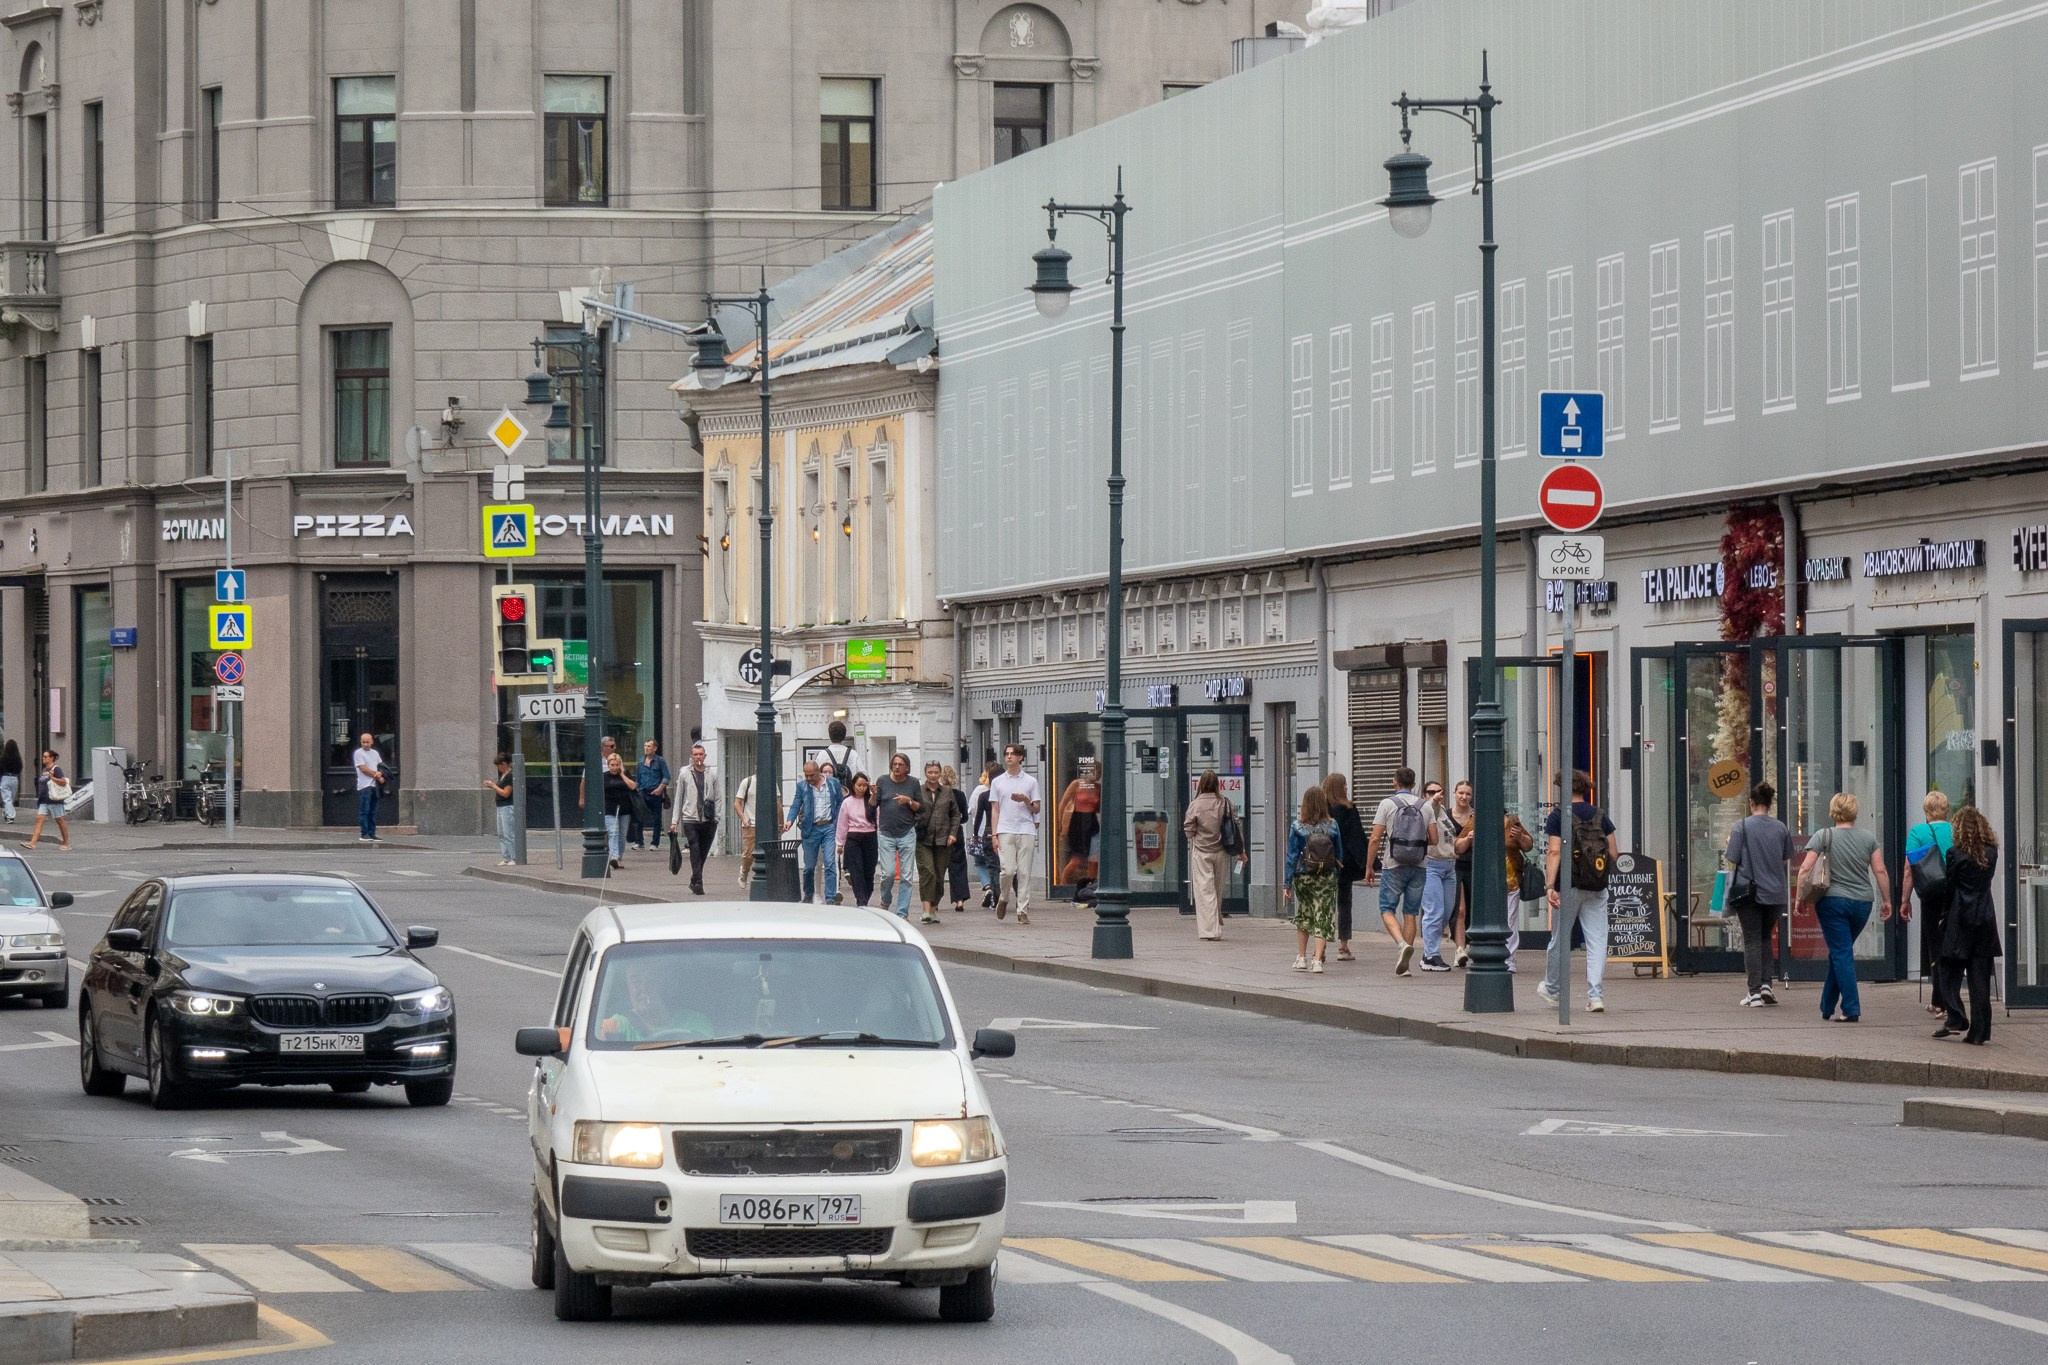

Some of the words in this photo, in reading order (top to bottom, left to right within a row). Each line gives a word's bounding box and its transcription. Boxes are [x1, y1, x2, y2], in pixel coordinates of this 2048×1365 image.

[163, 518, 225, 541] ZOTMAN
[294, 515, 414, 536] PIZZA
[1924, 539, 1976, 571] ТРИКОТАЖ
[2011, 525, 2048, 571] EYFE
[1552, 566, 1590, 575] КРОМЕ
[1805, 557, 1845, 581] ФОРАБАНК
[1641, 569, 1665, 603] TEA
[1667, 563, 1712, 601] PALACE
[1204, 679, 1221, 702] СИДР
[1221, 678, 1227, 698] &
[1227, 677, 1245, 697] ПИВО
[530, 698, 576, 715] СТОП
[1229, 779, 1241, 791] 24
[1712, 769, 1740, 789] LEBO
[285, 1036, 337, 1050] Т215НК
[340, 1035, 360, 1046] 799
[728, 1198, 815, 1221] А086РК
[820, 1198, 854, 1214] 797
